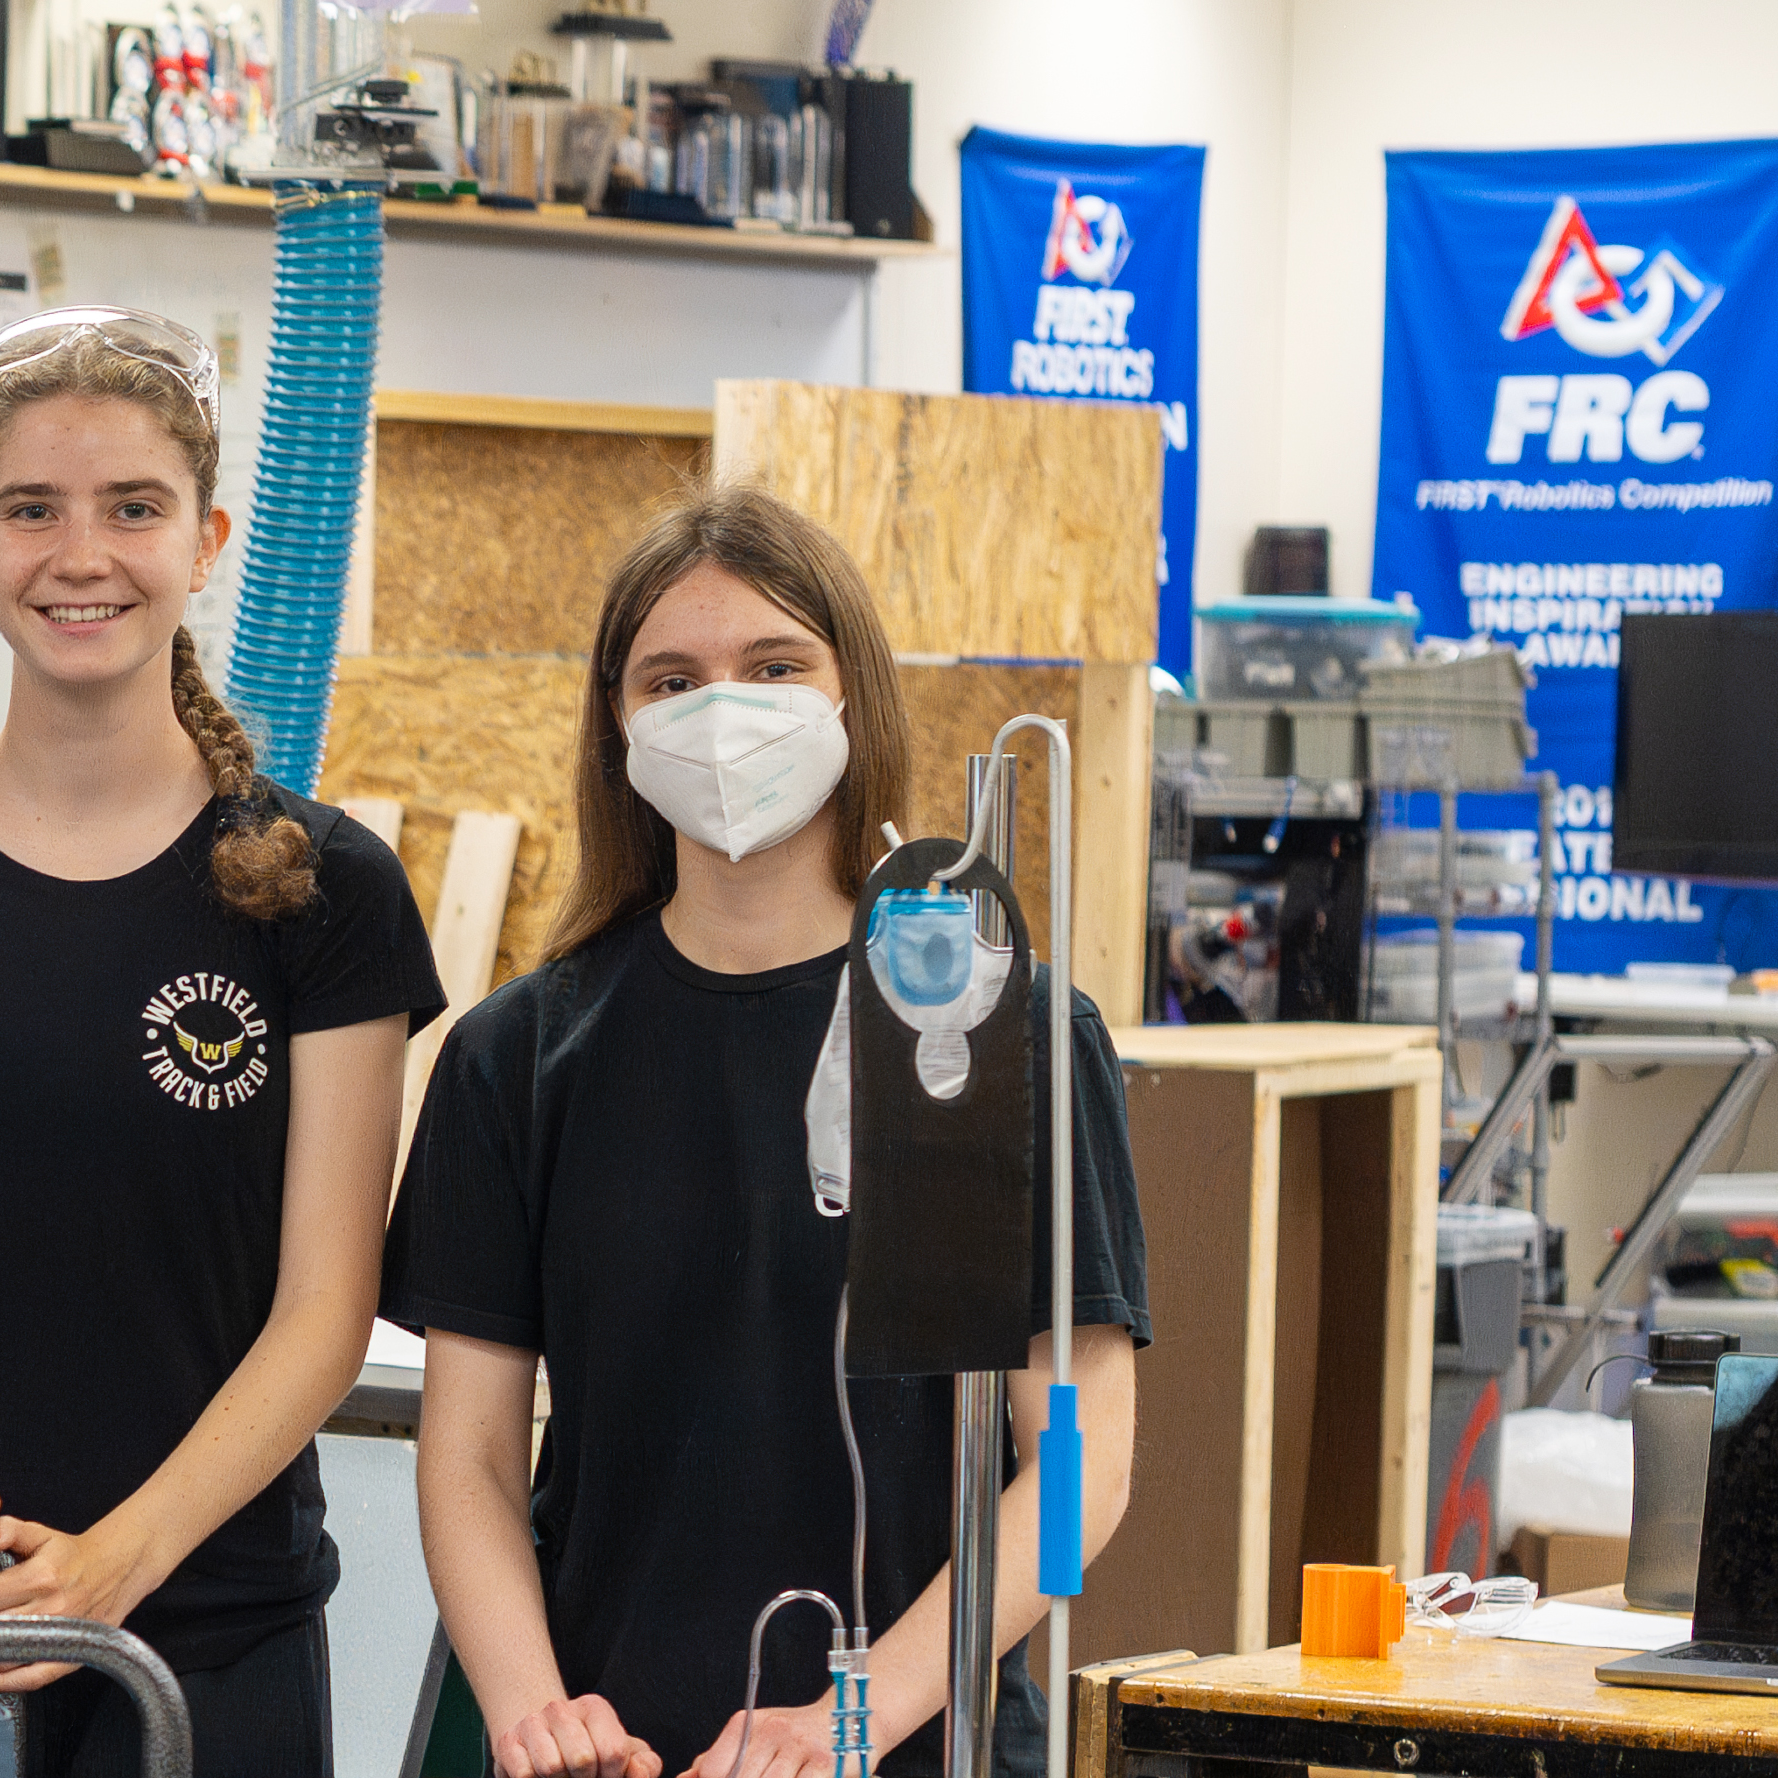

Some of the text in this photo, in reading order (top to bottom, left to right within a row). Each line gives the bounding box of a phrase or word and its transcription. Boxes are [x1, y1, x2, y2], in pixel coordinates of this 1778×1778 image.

[1484, 369, 1712, 464] FRC
[141, 971, 267, 1038] WESTFIELD
[142, 1046, 268, 1110] TRACK & FIELD
[200, 1042, 221, 1060] W
